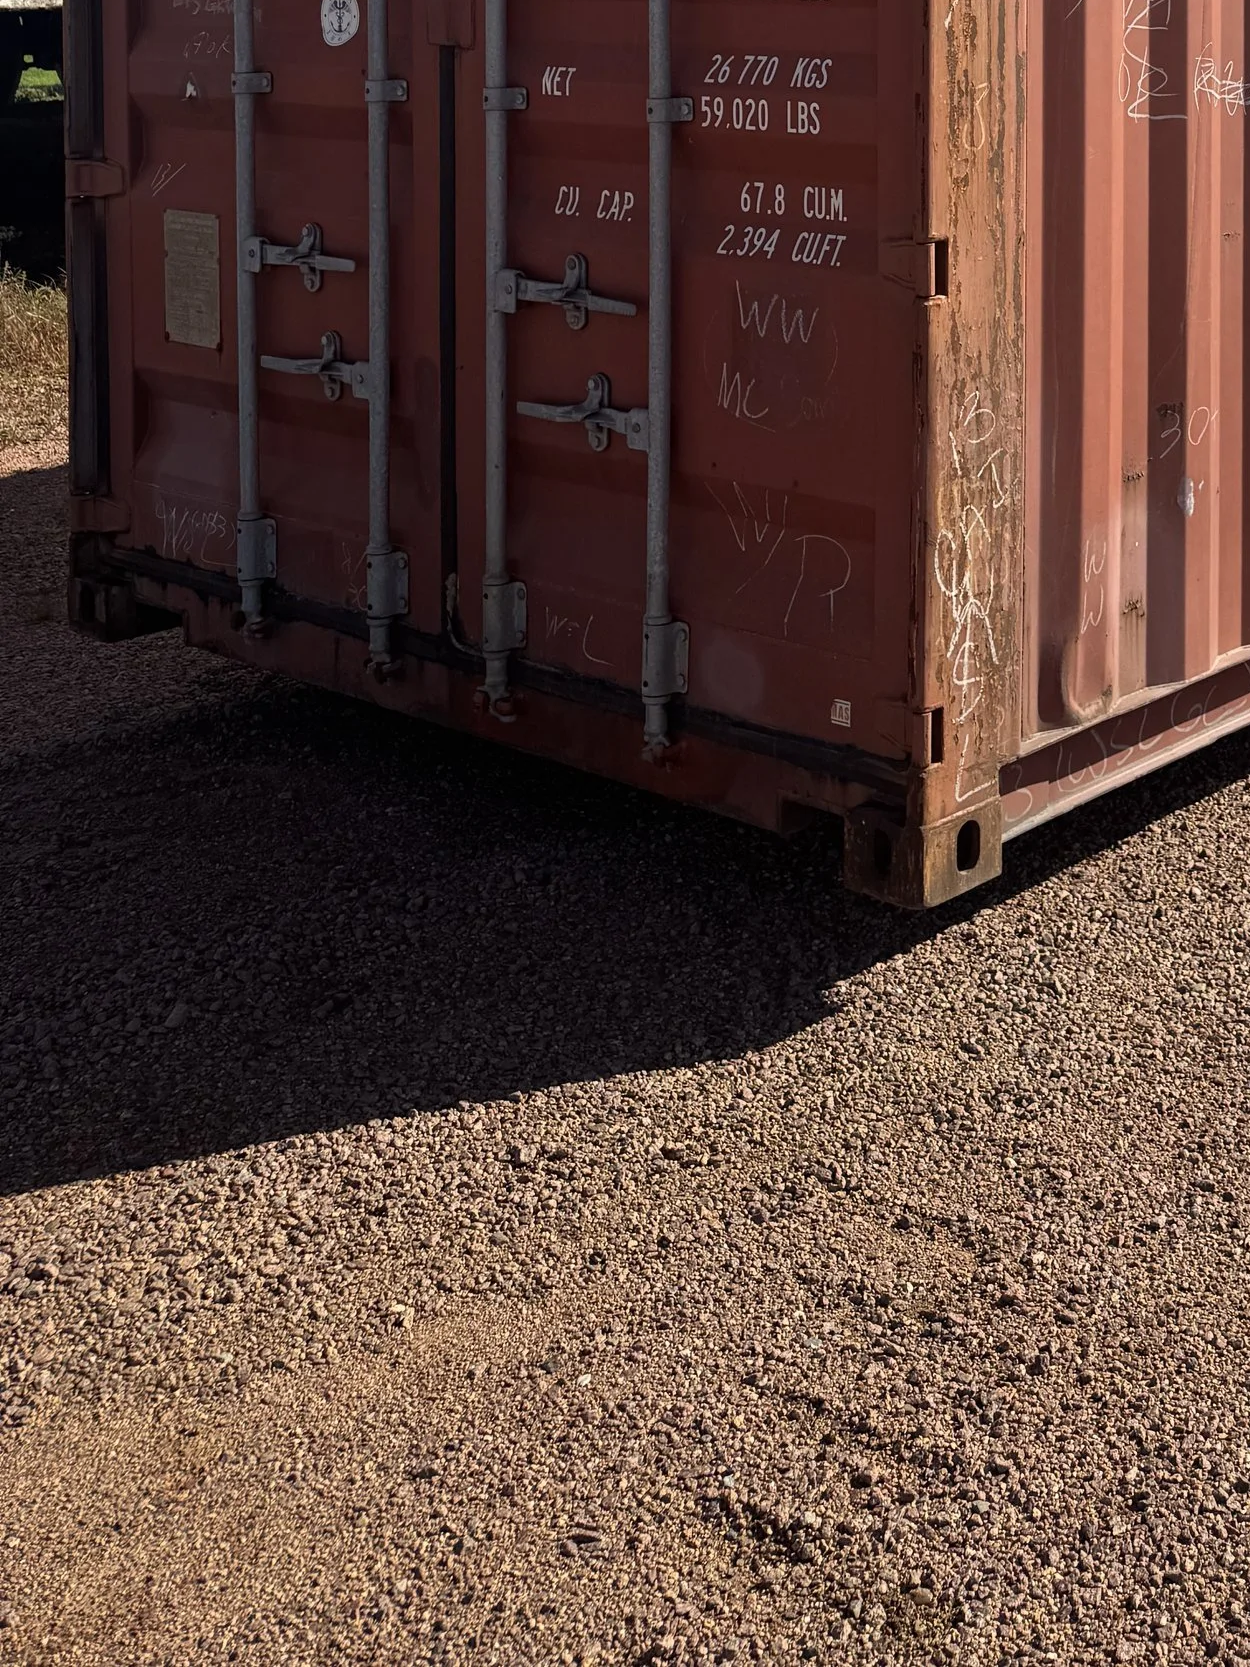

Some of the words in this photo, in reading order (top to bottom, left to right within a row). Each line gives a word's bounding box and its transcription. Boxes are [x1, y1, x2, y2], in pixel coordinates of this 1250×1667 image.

[541, 65, 577, 96] NET
[789, 57, 833, 89] KGS
[787, 100, 821, 135] LBS
[555, 186, 580, 217] CU.
[597, 189, 635, 222] CAP.
[741, 181, 785, 215] 67.8
[803, 185, 848, 222] CU.M.
[716, 224, 781, 259] 2,394
